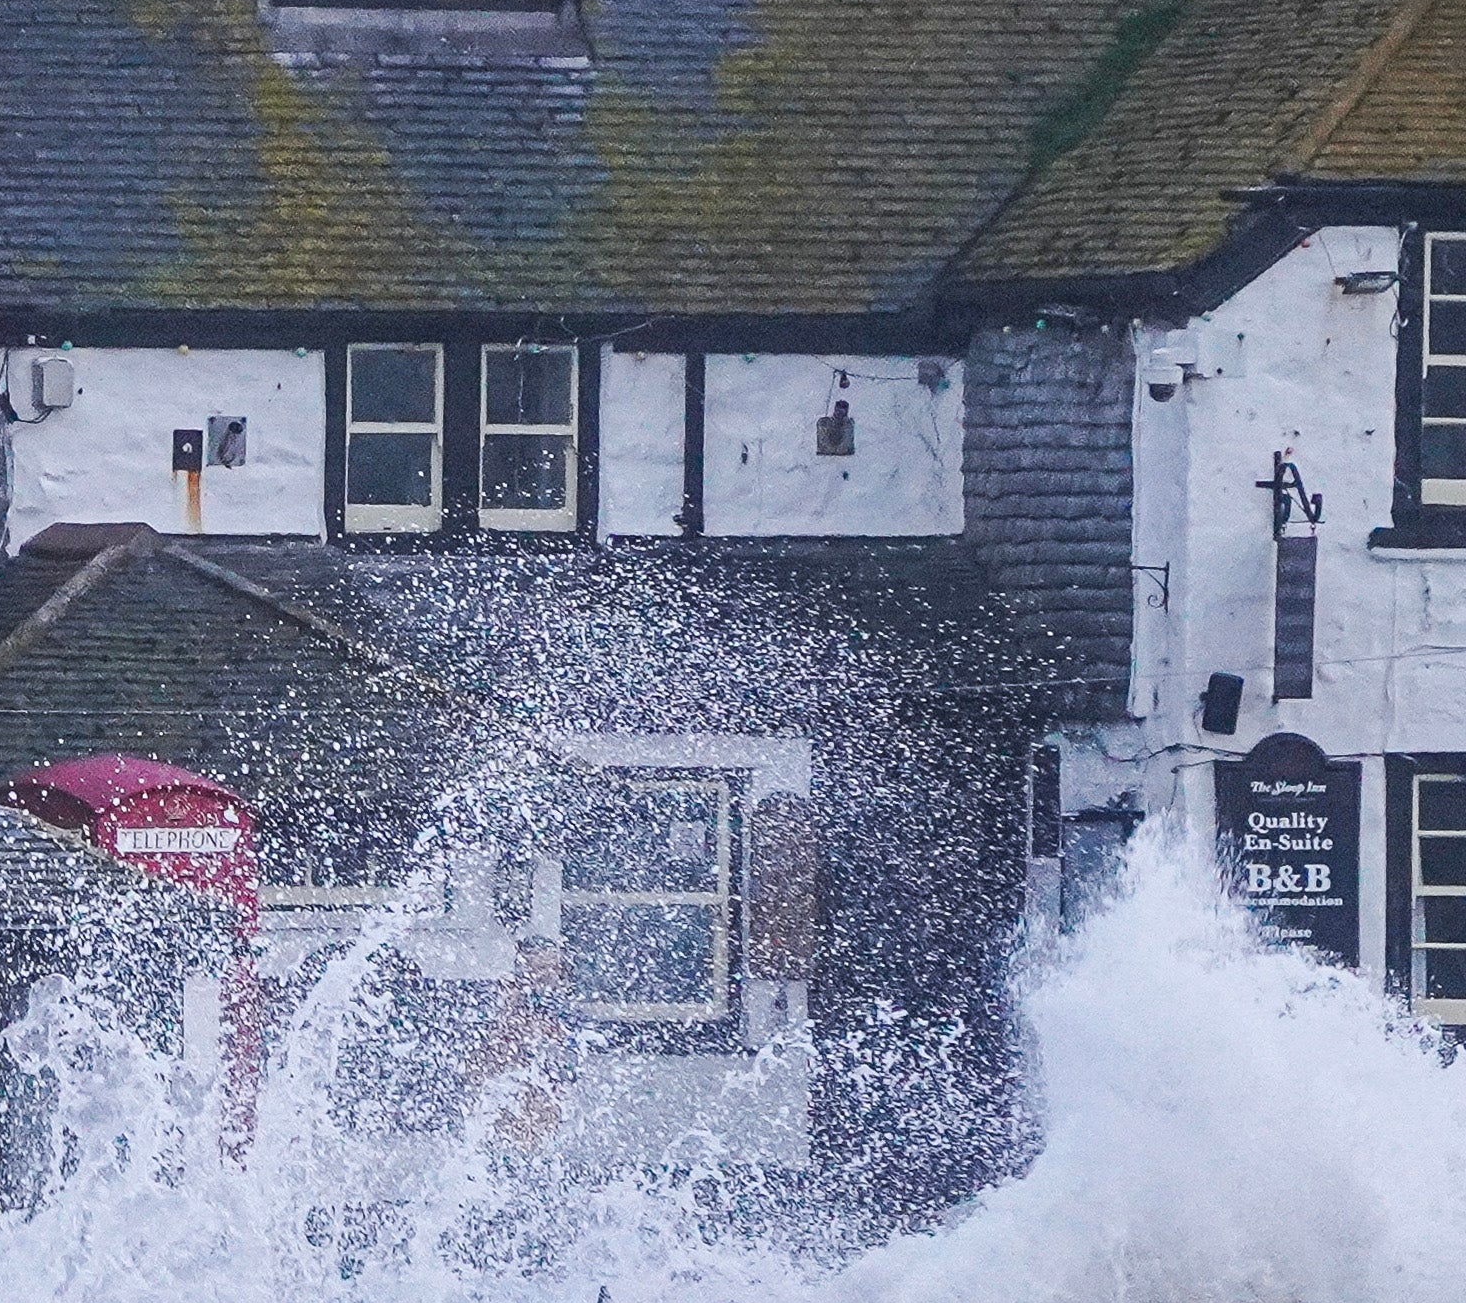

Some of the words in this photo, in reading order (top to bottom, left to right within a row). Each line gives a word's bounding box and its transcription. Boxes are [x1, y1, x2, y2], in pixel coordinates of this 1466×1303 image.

[1249, 780, 1272, 793] The
[1270, 780, 1306, 797] Sloop
[1247, 811, 1329, 834] Quality
[120, 830, 231, 849] TELEPHONE
[1244, 833, 1334, 851] En-Suite
[1247, 862, 1331, 893] B&B
[1238, 895, 1344, 906] commodation
